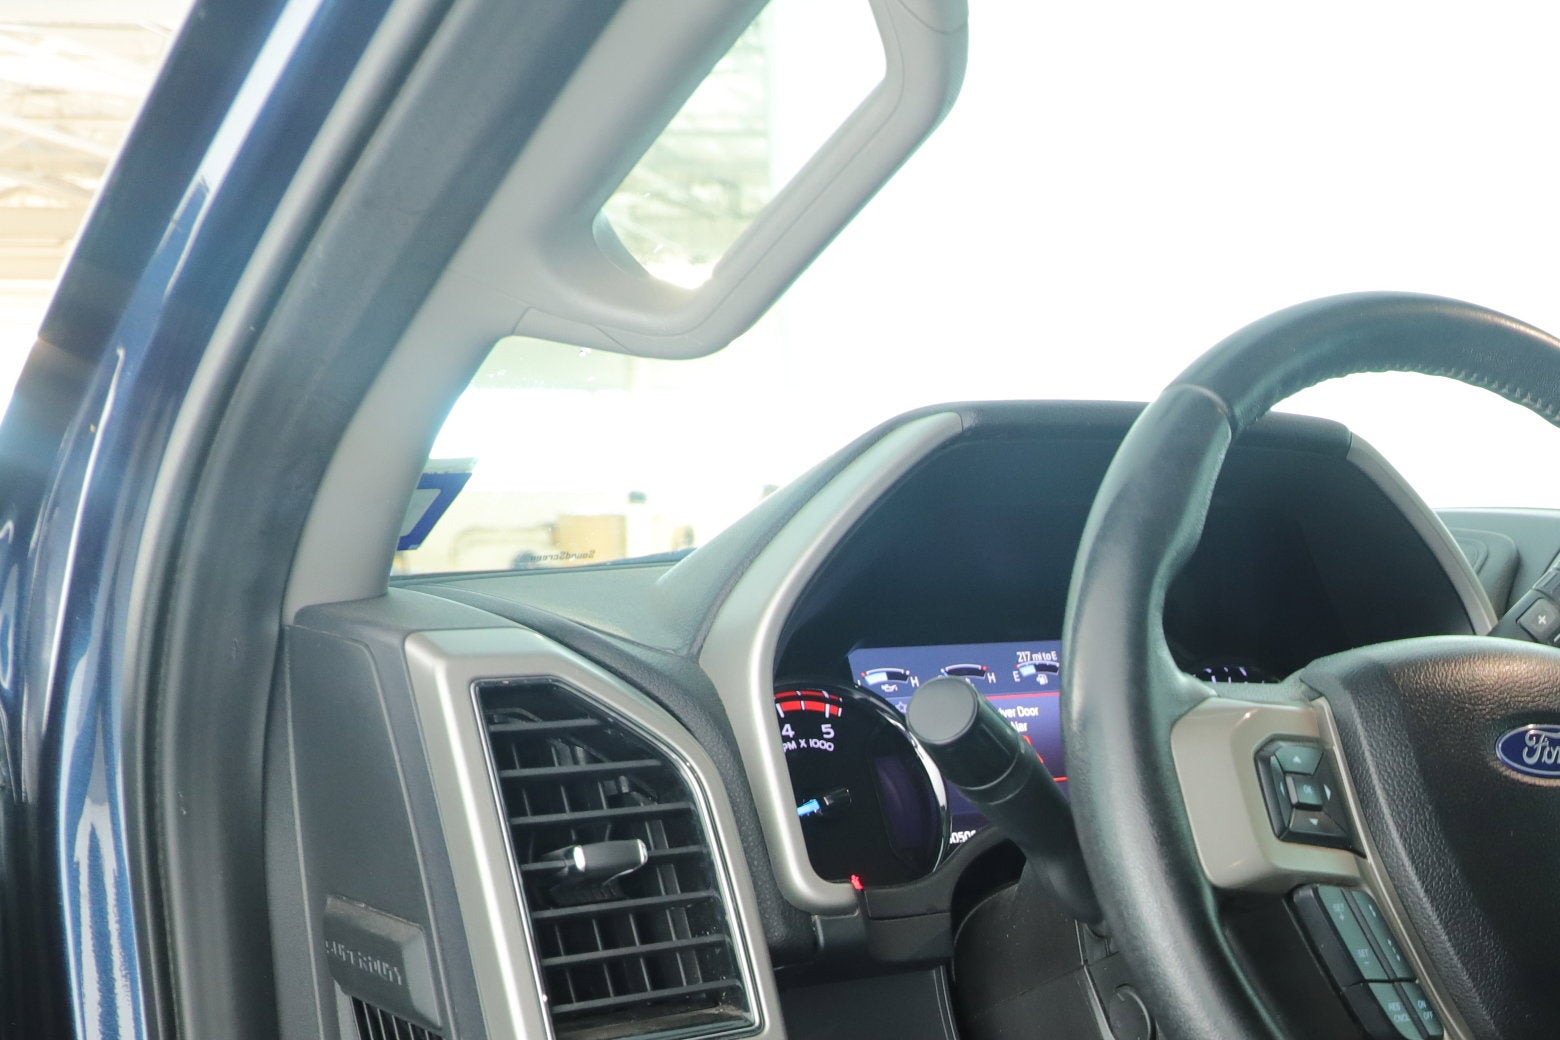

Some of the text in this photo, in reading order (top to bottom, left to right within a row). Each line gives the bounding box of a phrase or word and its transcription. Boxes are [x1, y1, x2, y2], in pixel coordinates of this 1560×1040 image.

[1016, 651, 1031, 663] 217
[910, 675, 919, 687] H
[987, 672, 996, 684] H
[1012, 670, 1021, 682] E
[1016, 705, 1039, 717] Door
[781, 723, 795, 738] 4
[821, 723, 835, 739] 5
[809, 738, 835, 751] 1000
